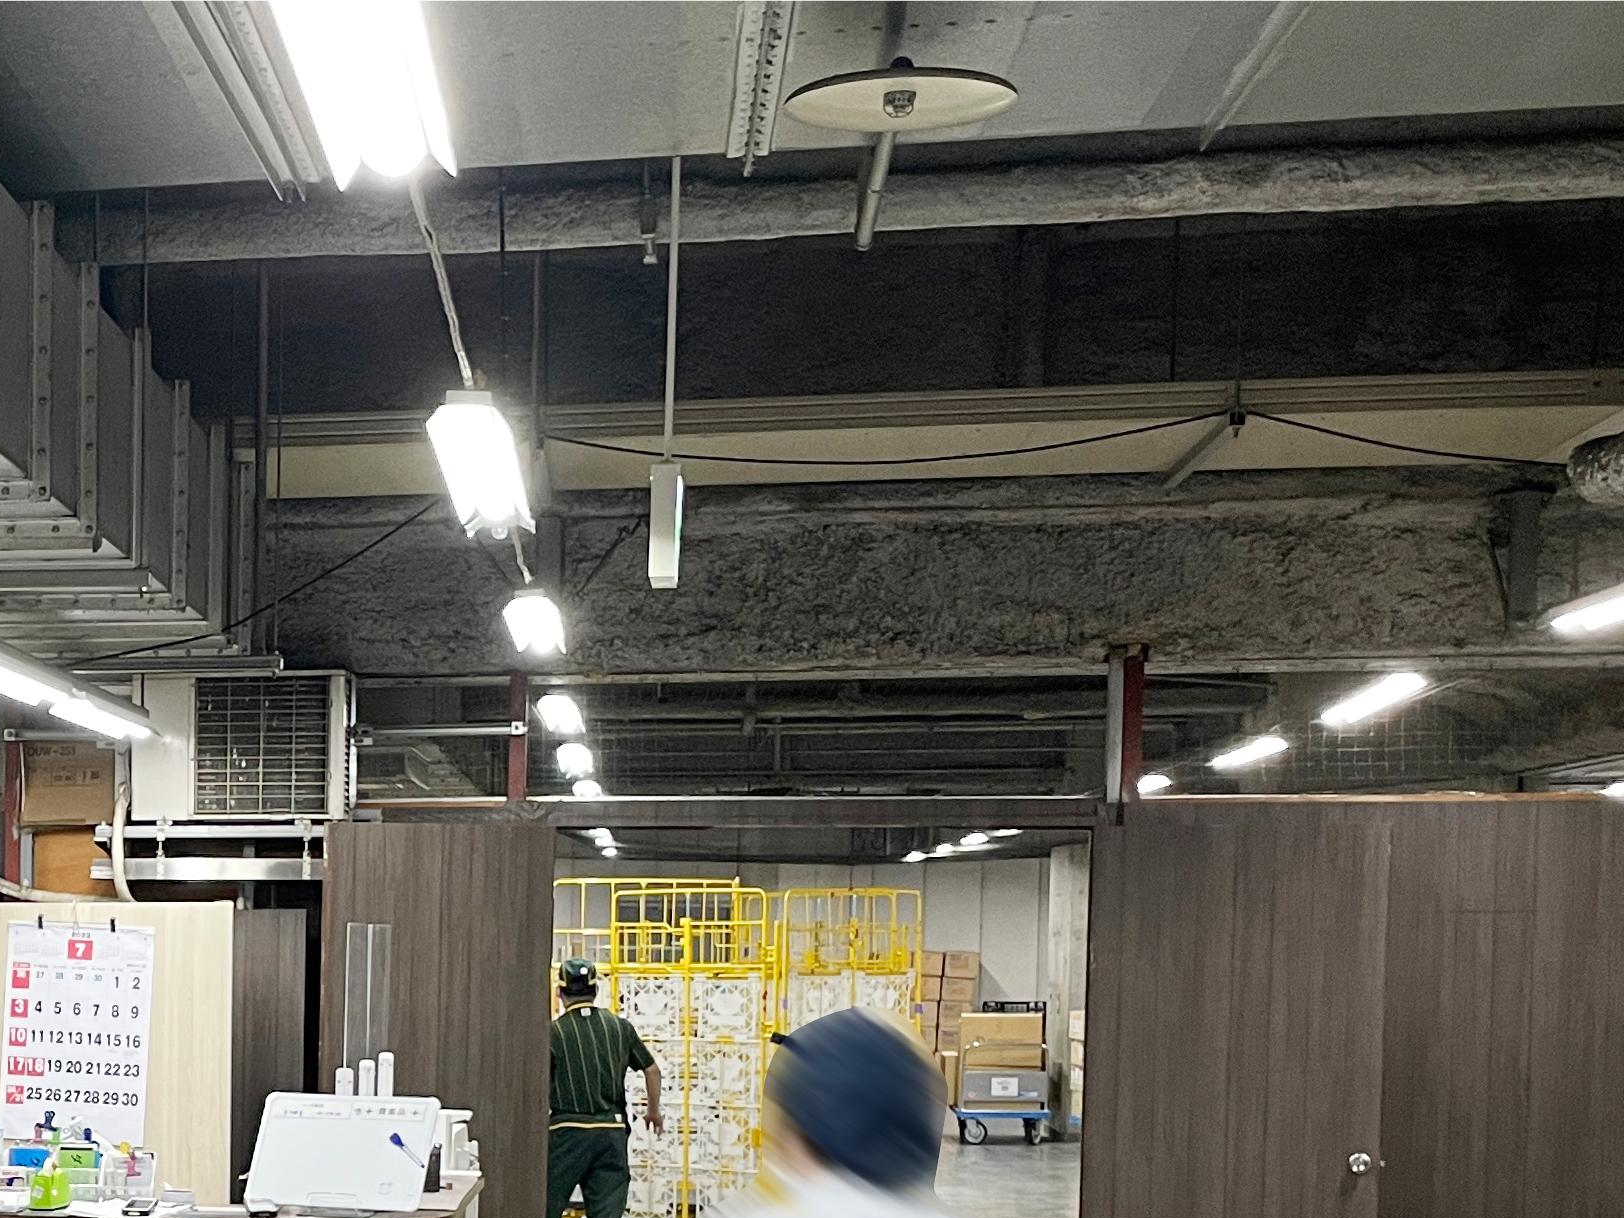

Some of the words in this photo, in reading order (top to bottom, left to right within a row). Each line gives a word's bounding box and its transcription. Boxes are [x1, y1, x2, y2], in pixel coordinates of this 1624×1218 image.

[74, 942, 86, 958] 7
[115, 976, 119, 988] 1
[132, 977, 141, 990] 2
[14, 999, 24, 1013] 3
[34, 1001, 42, 1013] 4
[54, 1002, 62, 1015] 5
[73, 1003, 81, 1016] 6
[93, 1004, 100, 1017] 7
[111, 1005, 119, 1018] 8
[130, 1006, 139, 1019] 9
[10, 1028, 26, 1041] 10
[31, 1030, 44, 1043] 11
[49, 1030, 64, 1044] 12
[68, 1031, 83, 1045] 13
[87, 1032, 102, 1046] 14
[106, 1034, 122, 1047] 15
[126, 1035, 141, 1049] 16
[8, 1057, 25, 1071] 17
[27, 1058, 44, 1073] 18
[47, 1059, 62, 1073] 19
[66, 1060, 82, 1074] 20
[85, 1061, 101, 1075] 21
[103, 1063, 120, 1076] 22
[123, 1064, 140, 1078] 23
[26, 1087, 42, 1100] 25
[45, 1088, 62, 1101] 26
[64, 1090, 81, 1103] 27
[83, 1091, 100, 1104] 28
[102, 1092, 119, 1106] 29
[121, 1093, 138, 1107] 30
